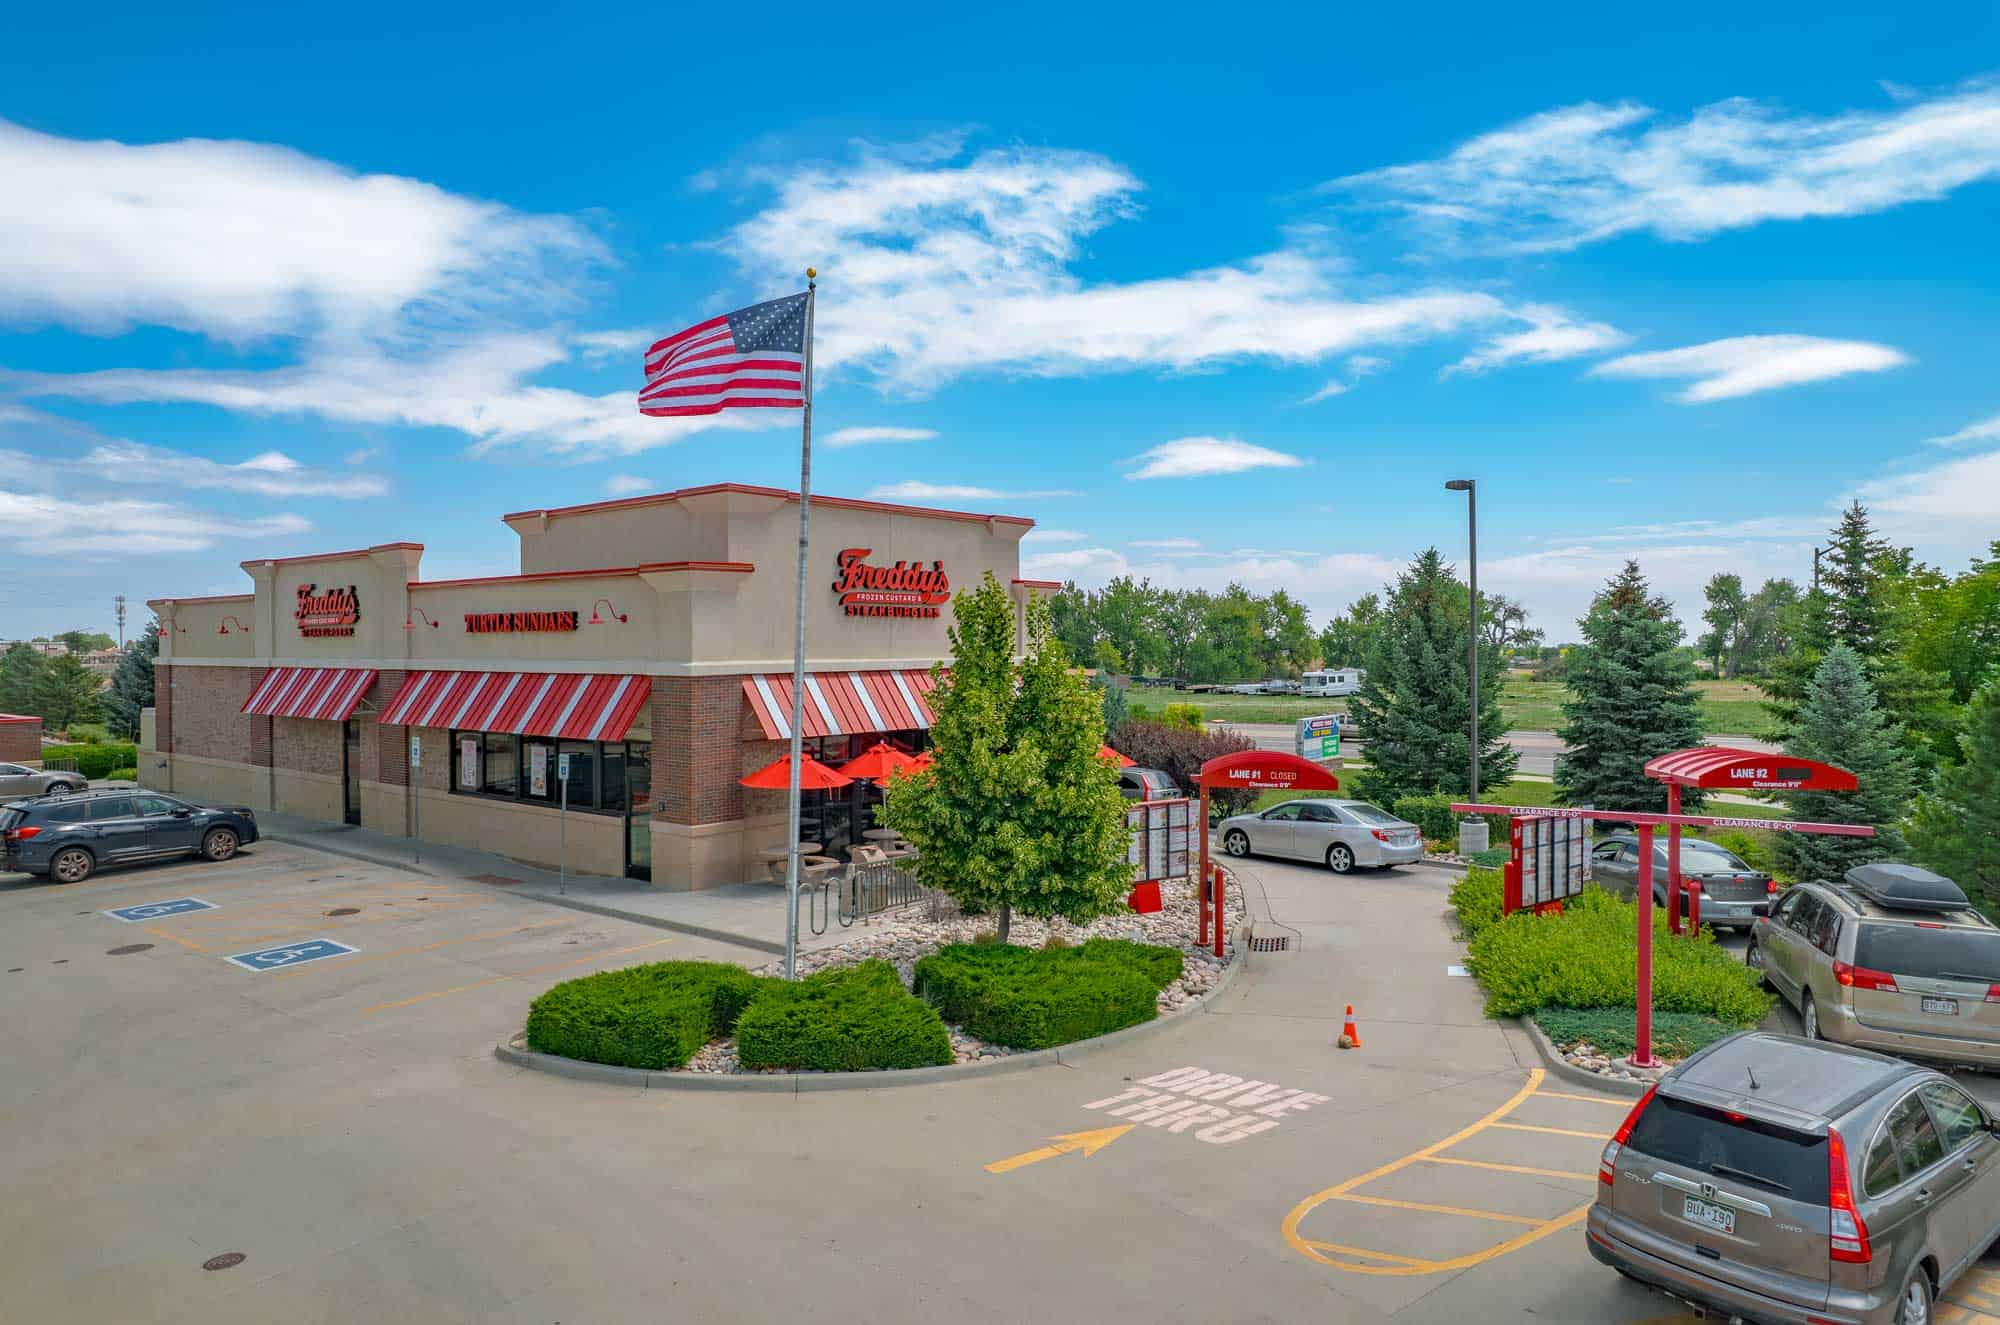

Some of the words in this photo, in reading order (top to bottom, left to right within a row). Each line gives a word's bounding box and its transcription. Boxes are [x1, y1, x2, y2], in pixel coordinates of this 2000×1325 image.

[833, 548, 949, 593] Freddy's
[294, 583, 359, 619] Freddy's
[856, 593, 884, 601] FROZEN
[885, 594, 916, 602] CUSTARD
[846, 605, 941, 618] STEAKBURGERS
[463, 612, 513, 633] TURTLE
[514, 610, 578, 632] SUNDAES
[1229, 768, 1250, 779] LANE
[1251, 769, 1261, 779] #1
[1270, 771, 1297, 781] CLOSED
[1730, 767, 1755, 779] LANE
[1756, 768, 1768, 779] #2
[1509, 807, 1560, 817] CLEARANCE
[1712, 819, 1771, 830] CLEARANCE
[1136, 1065, 1333, 1118] DRIVE
[1079, 1087, 1281, 1145] THRU
